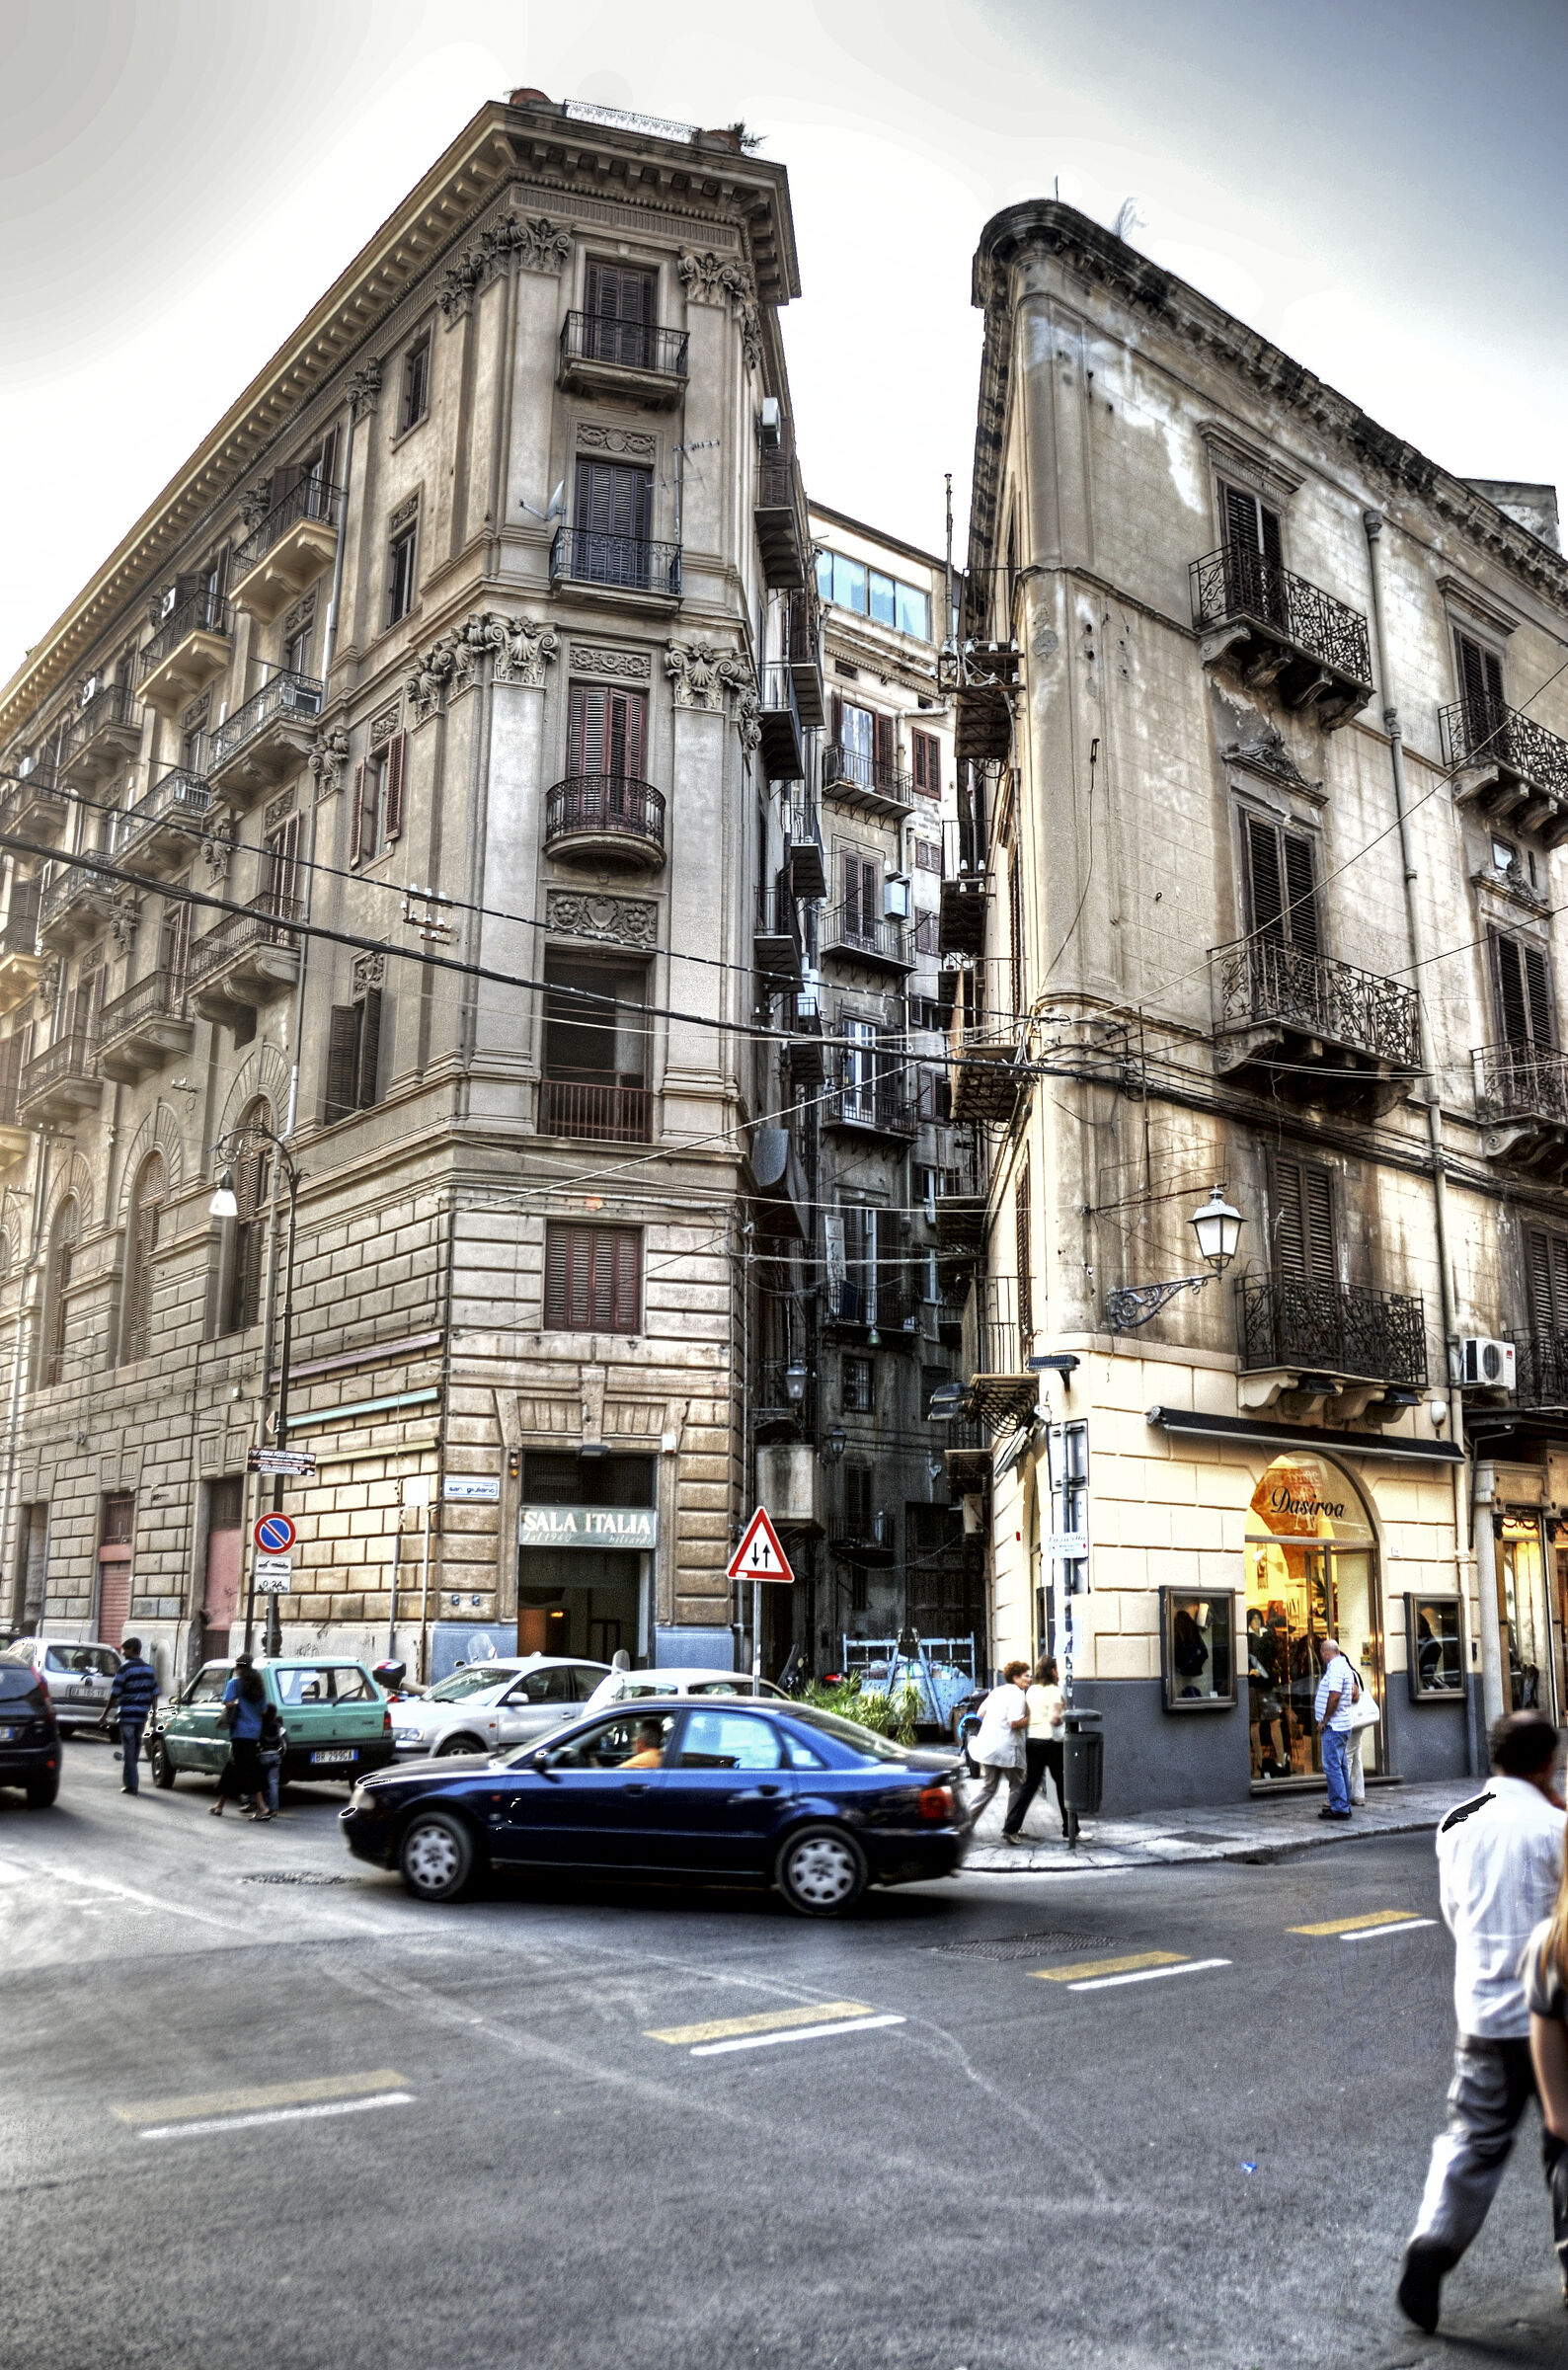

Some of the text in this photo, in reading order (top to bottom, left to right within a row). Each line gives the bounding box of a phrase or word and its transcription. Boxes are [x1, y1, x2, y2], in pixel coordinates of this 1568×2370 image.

[1270, 1485, 1345, 1519] Dasiroa
[522, 1510, 652, 1535] SALA ITALIA
